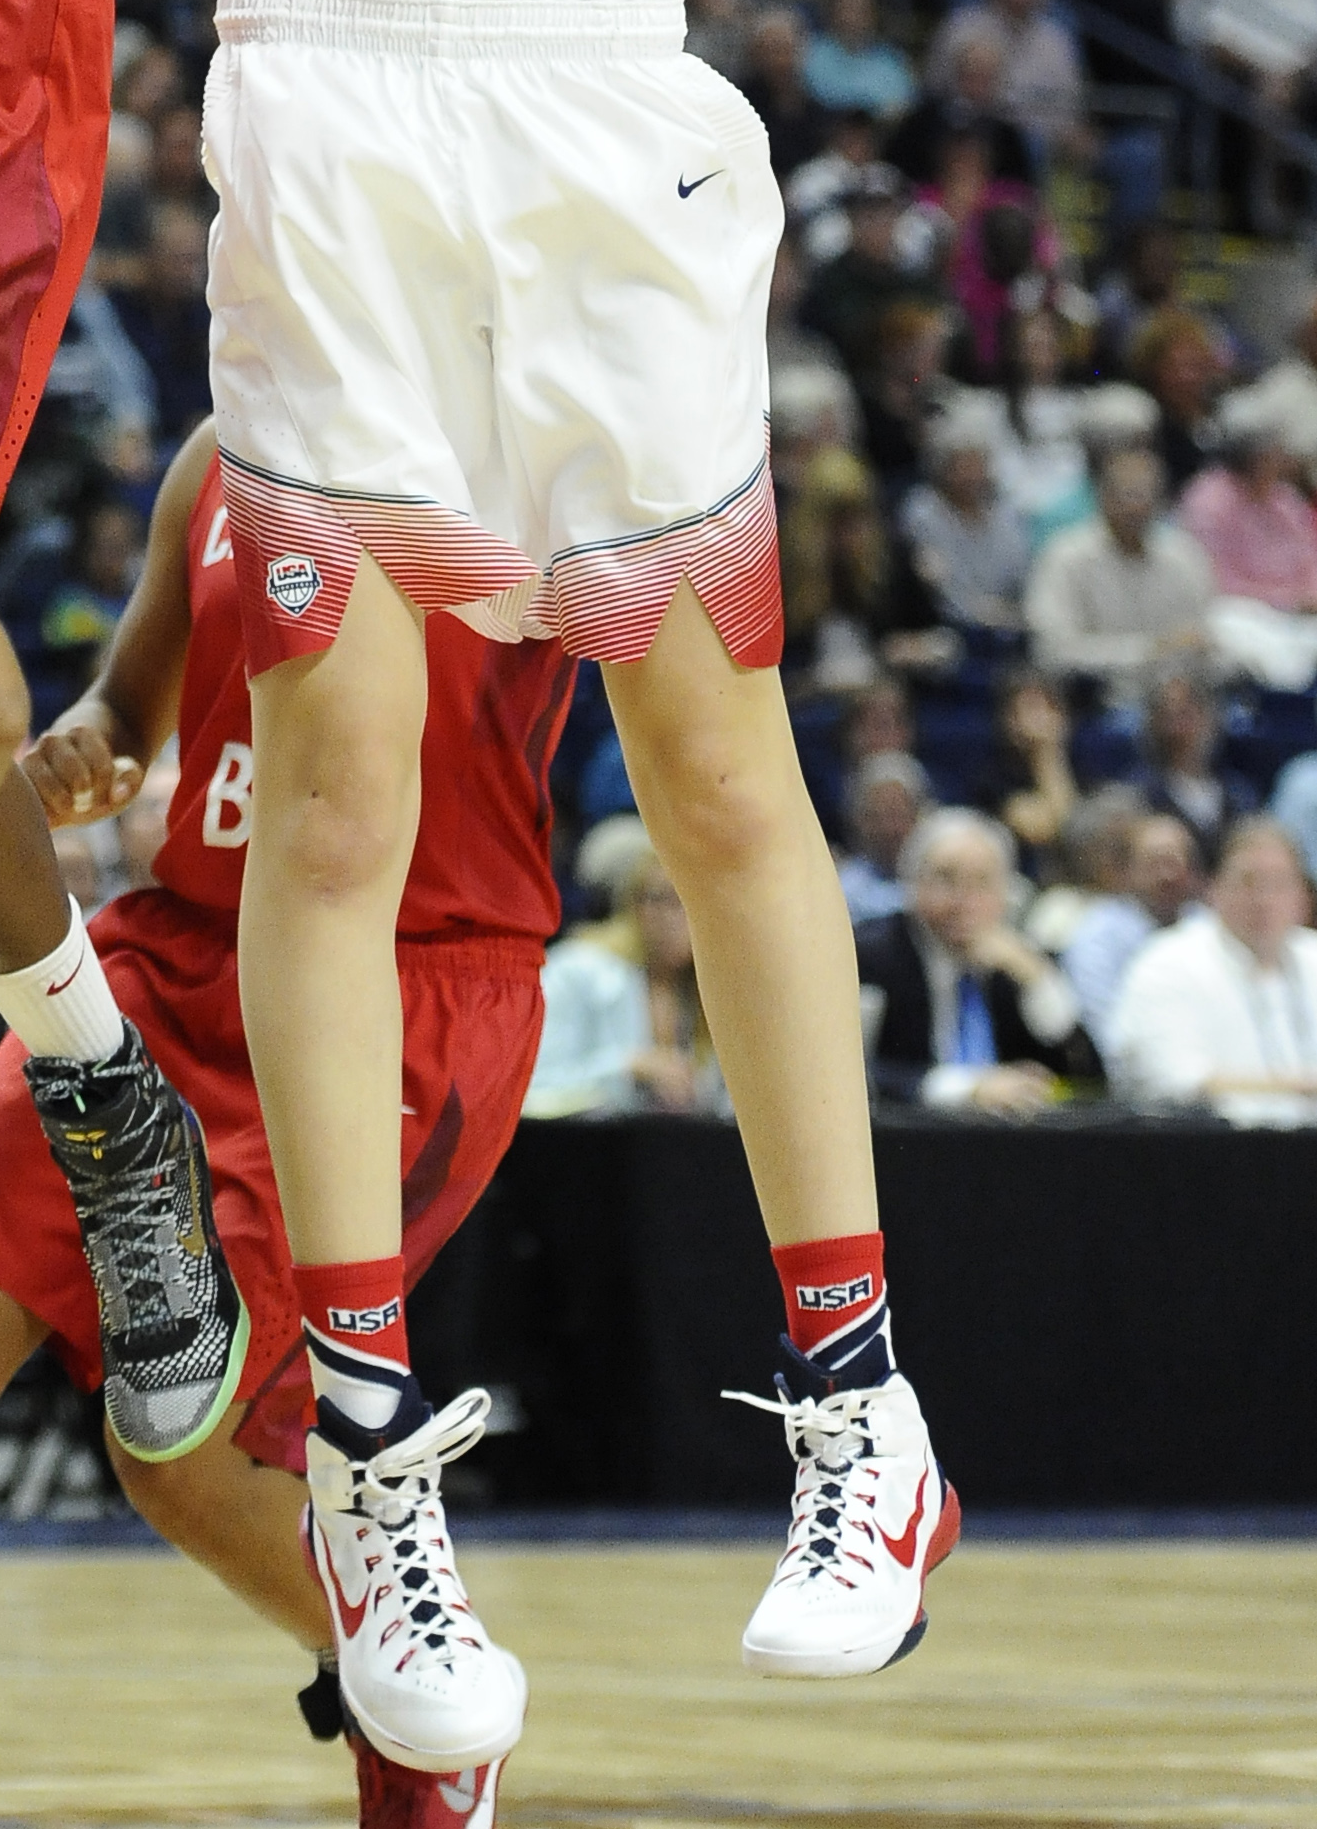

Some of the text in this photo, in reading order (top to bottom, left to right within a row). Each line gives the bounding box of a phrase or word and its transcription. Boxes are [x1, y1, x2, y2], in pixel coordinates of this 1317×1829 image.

[276, 564, 309, 581] USA
[797, 1275, 871, 1309] USA
[329, 1299, 399, 1333] USA
